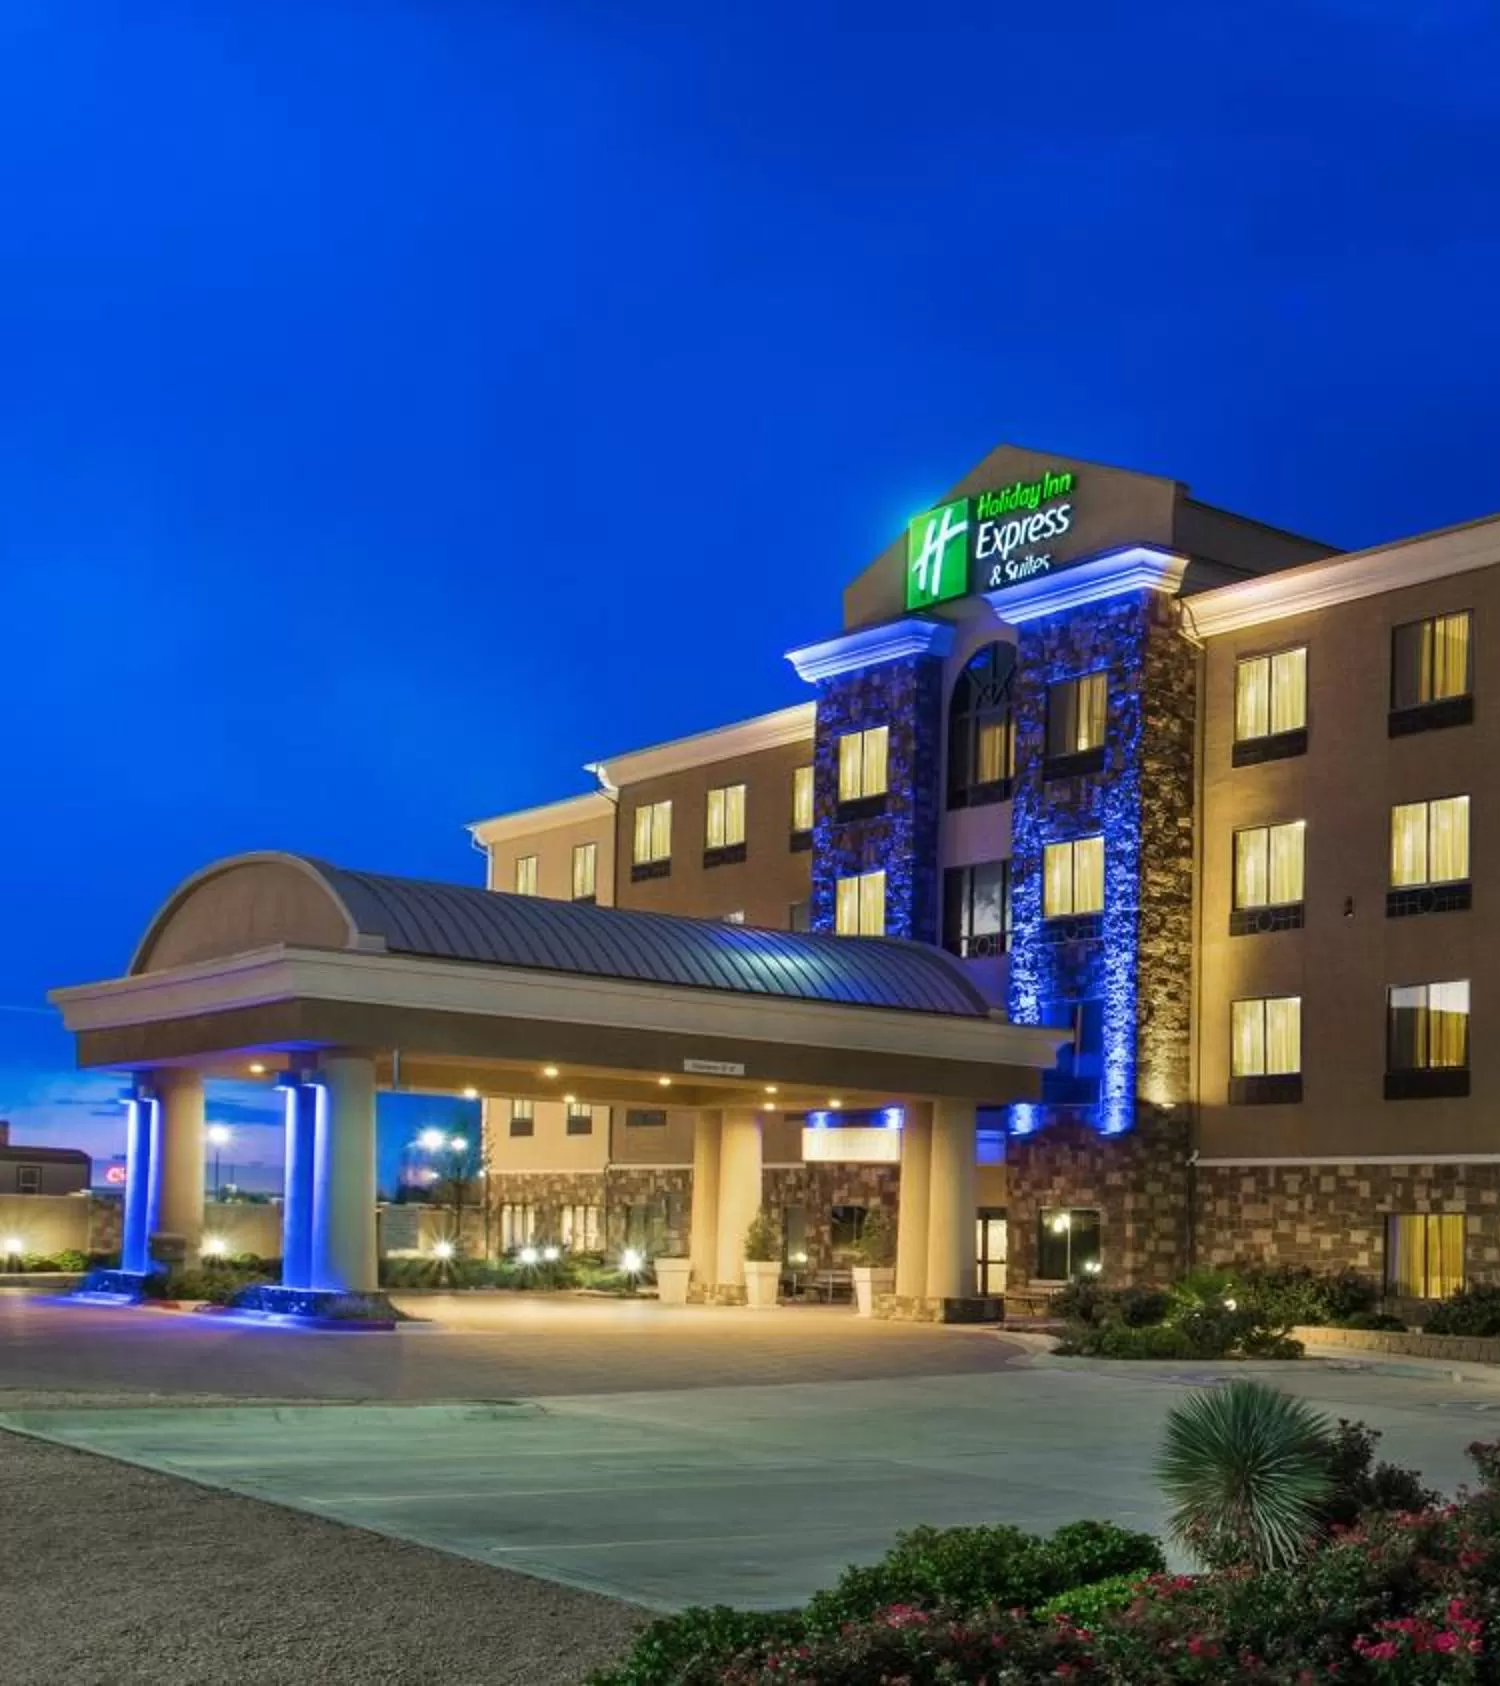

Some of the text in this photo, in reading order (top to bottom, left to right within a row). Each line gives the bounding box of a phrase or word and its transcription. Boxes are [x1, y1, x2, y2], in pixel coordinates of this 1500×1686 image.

[977, 471, 1072, 521] Holiday Inn
[975, 503, 1071, 560] Express
[990, 554, 1050, 587] & Suites
